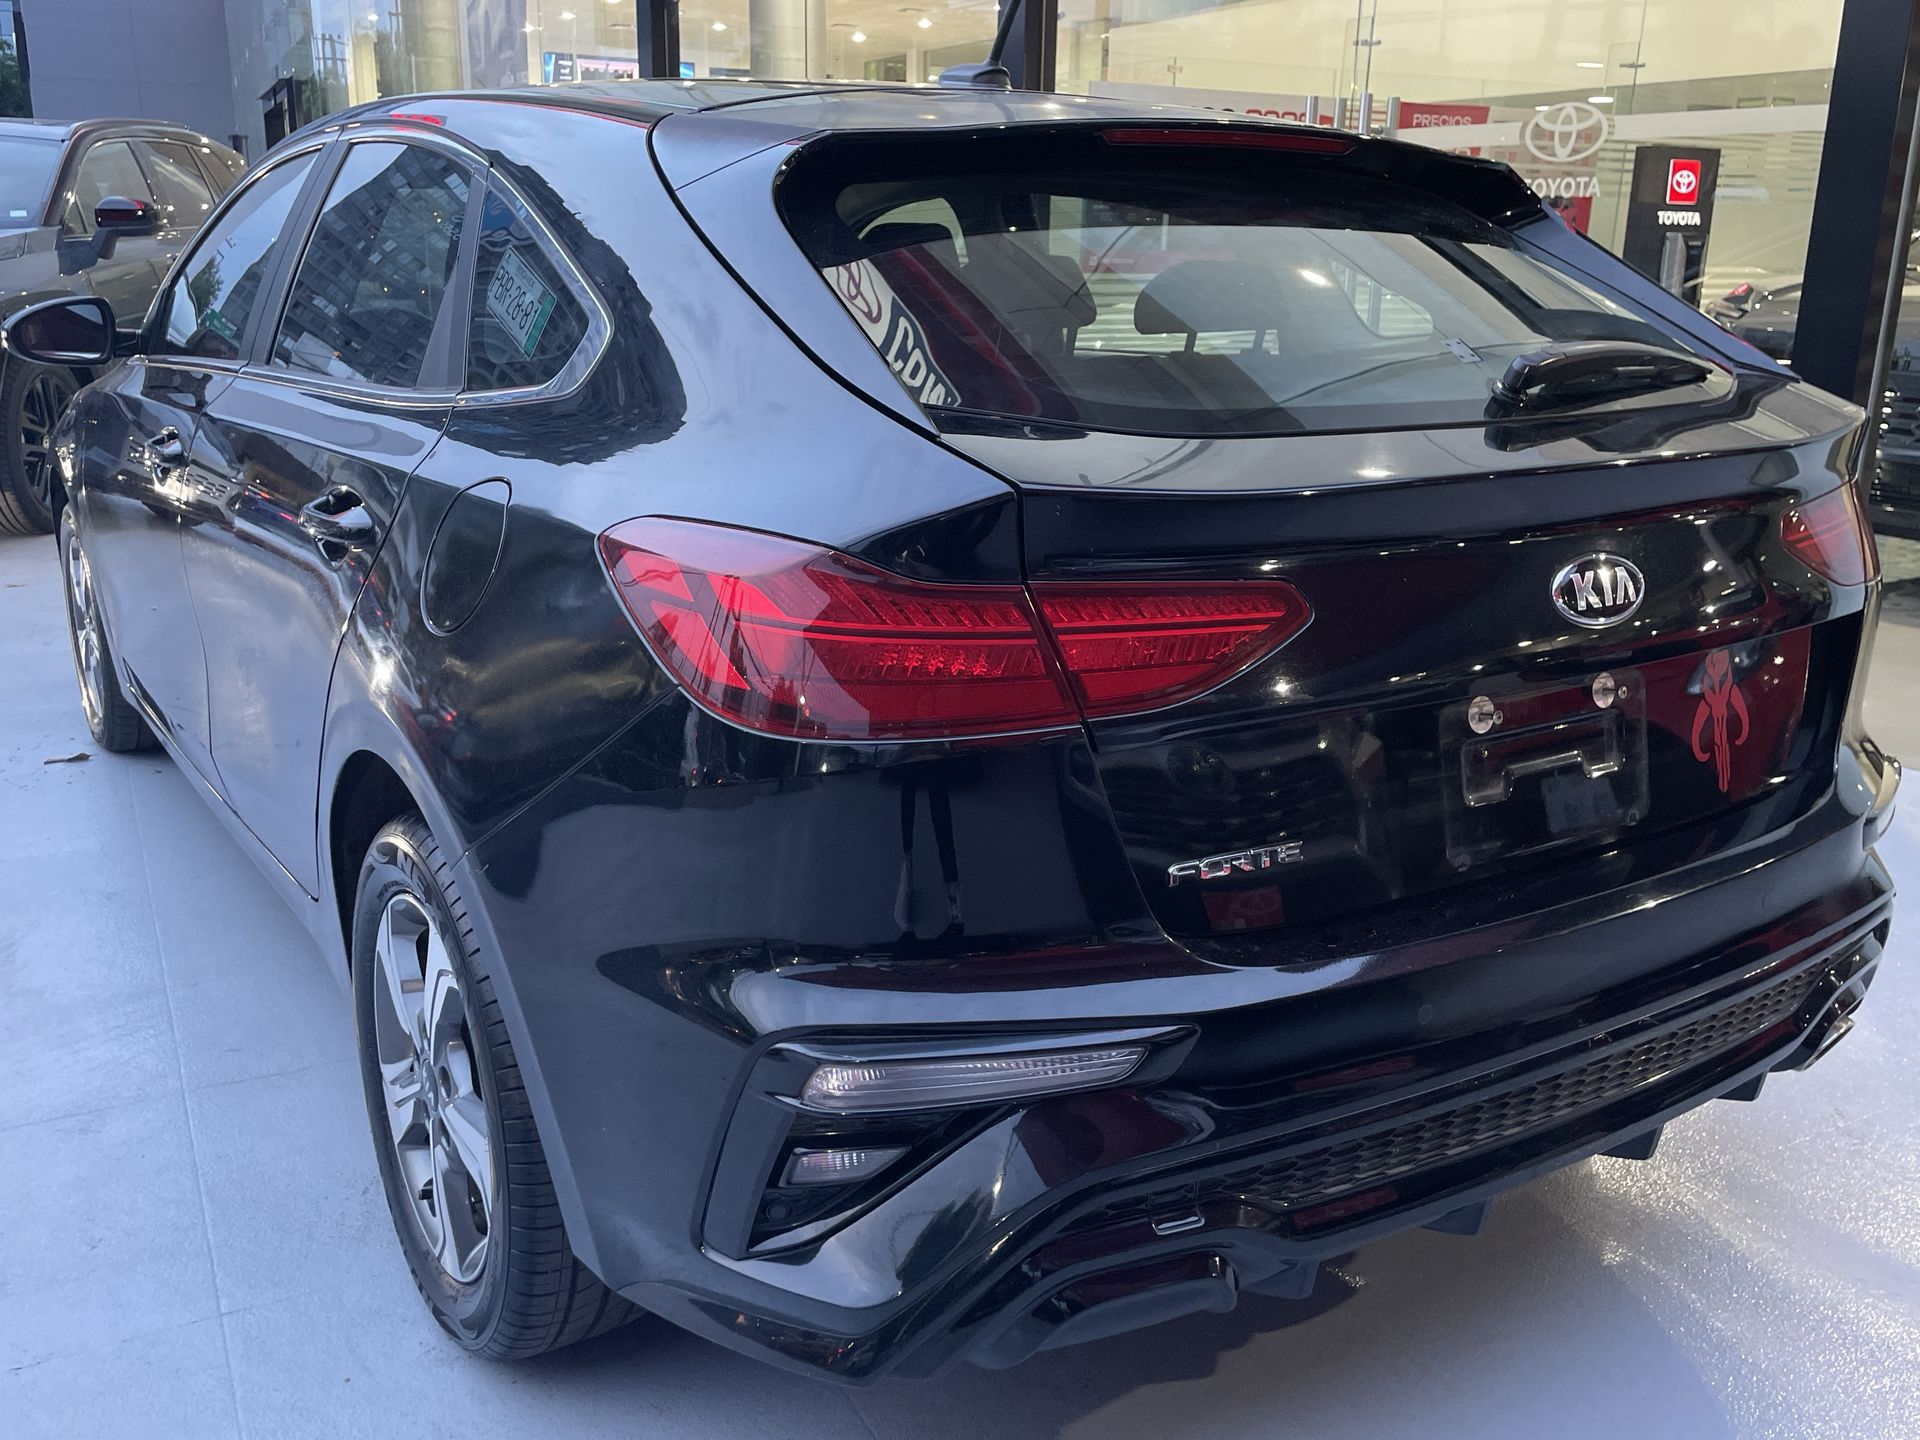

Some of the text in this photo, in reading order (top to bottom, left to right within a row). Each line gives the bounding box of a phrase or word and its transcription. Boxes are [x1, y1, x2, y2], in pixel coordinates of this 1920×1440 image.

[1412, 113, 1473, 127] PRECIOS
[1656, 210, 1702, 226] TOYOTA
[489, 265, 540, 337] PBR-28-81
[1570, 566, 1637, 611] KIA
[1167, 841, 1305, 887] FORTE
